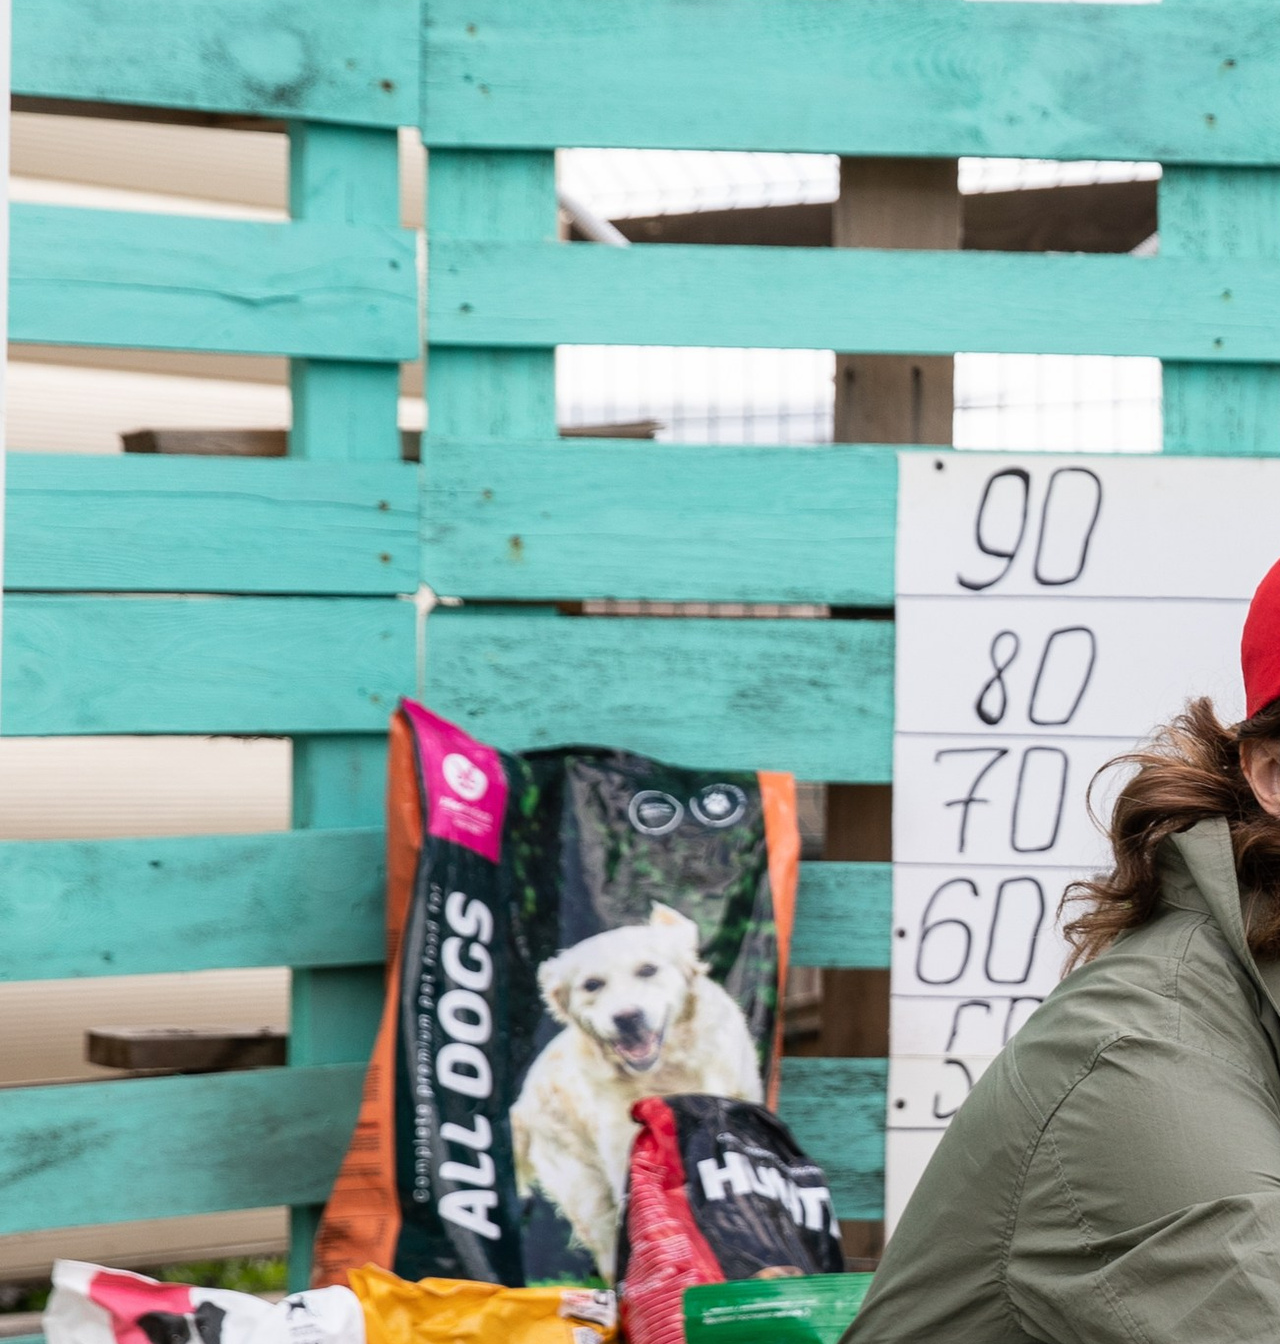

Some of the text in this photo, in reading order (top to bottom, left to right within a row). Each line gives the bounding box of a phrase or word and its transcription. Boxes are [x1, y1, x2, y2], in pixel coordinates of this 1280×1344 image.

[957, 466, 1102, 591] 90
[975, 625, 1097, 726] 80
[935, 746, 1068, 854] 70
[422, 919, 441, 967] food
[915, 877, 1045, 984] 60
[418, 973, 436, 1009] pet
[435, 890, 495, 1099] DOGS
[416, 1014, 435, 1098] premium
[413, 1104, 434, 1204] Complete
[437, 1114, 502, 1241] ALL
